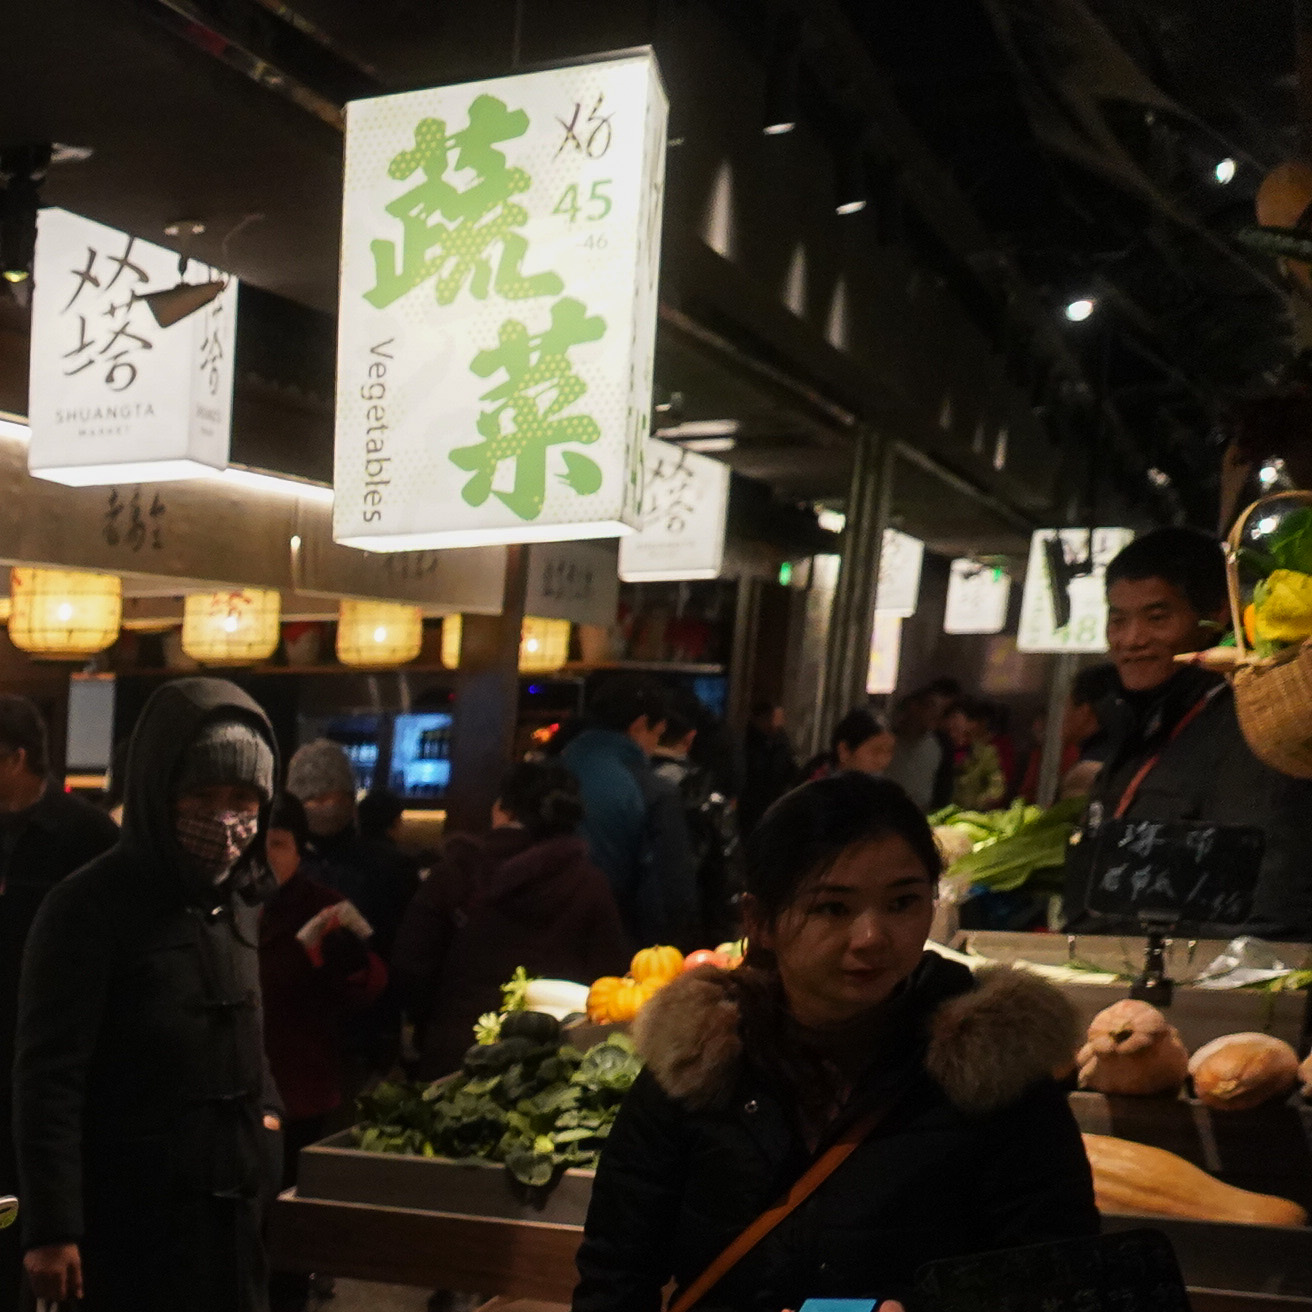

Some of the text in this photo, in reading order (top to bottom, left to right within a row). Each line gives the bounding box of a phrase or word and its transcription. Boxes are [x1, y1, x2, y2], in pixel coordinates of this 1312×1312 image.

[552, 178, 613, 223] 45
[361, 93, 608, 521] 蔬菜
[55, 403, 156, 424] SHUANGTA
[360, 338, 396, 523] Vegetables
